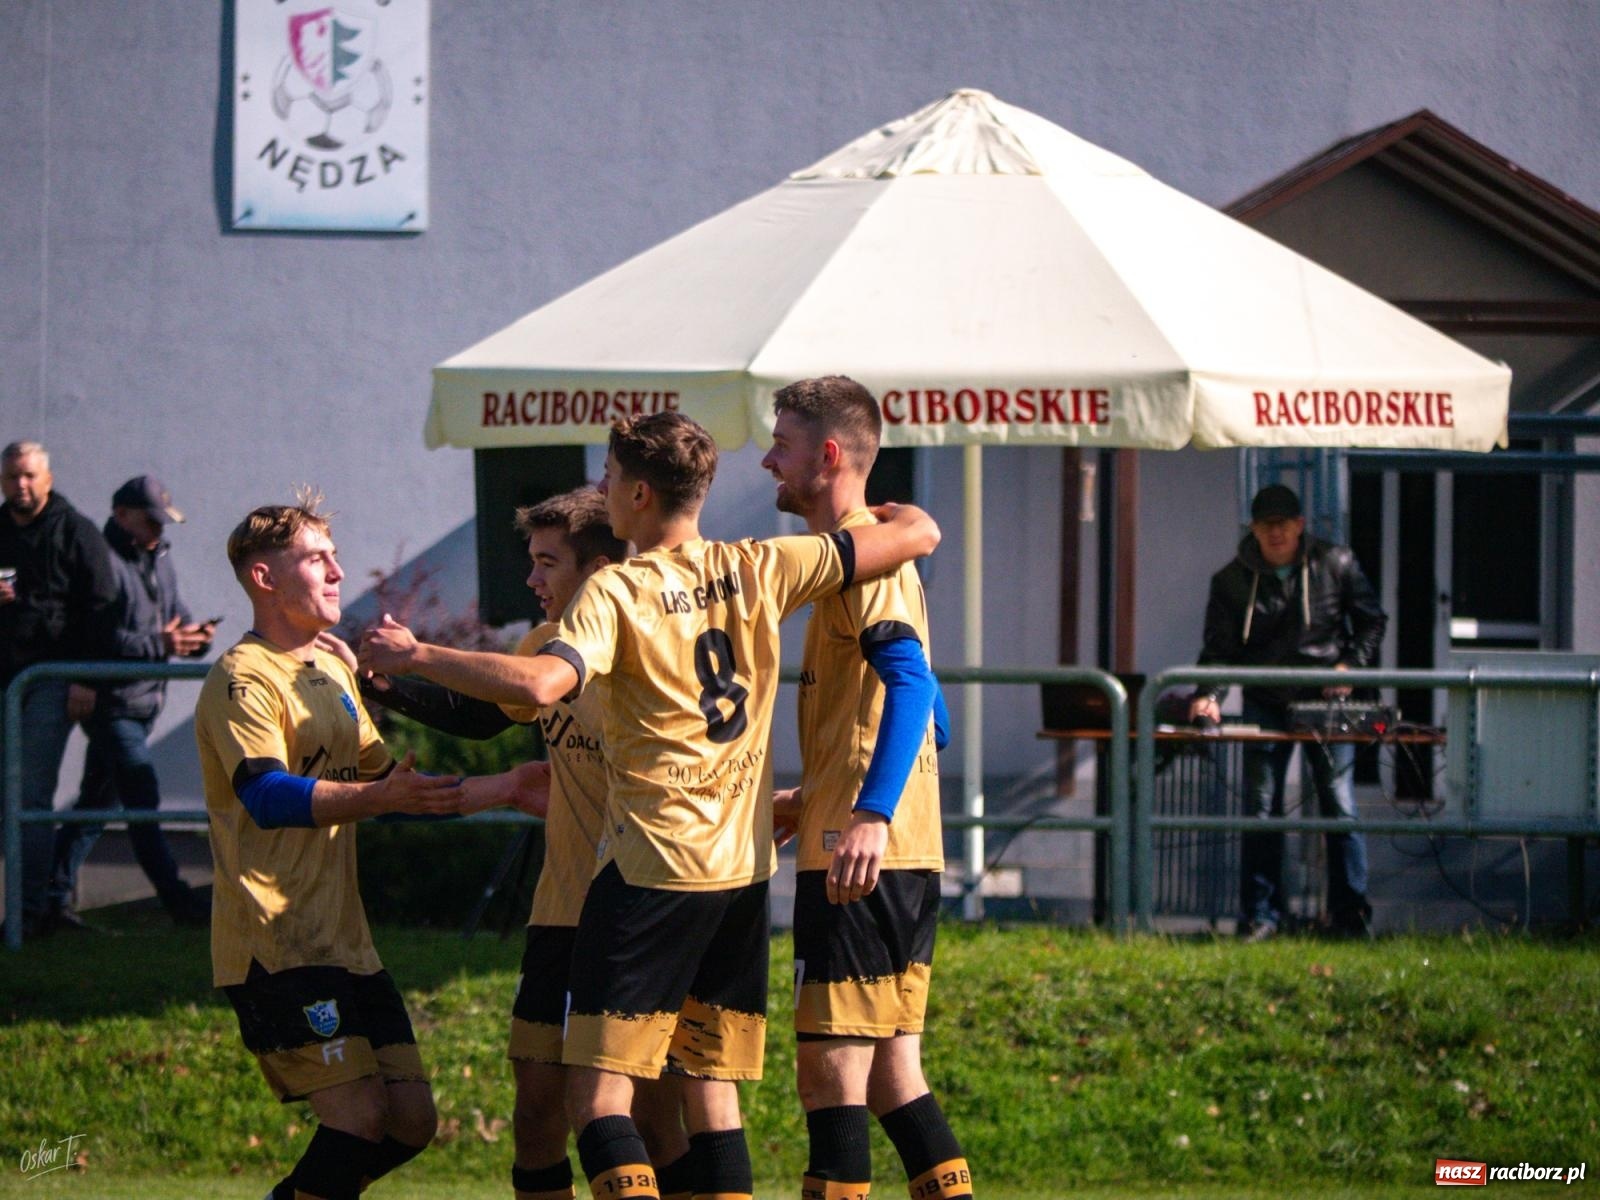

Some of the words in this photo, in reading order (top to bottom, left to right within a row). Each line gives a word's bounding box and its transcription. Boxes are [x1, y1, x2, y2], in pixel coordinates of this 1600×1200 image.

[257, 137, 406, 193] NĘDZA
[881, 388, 1110, 425] CIBORSKIE
[1253, 390, 1454, 428] RACIBORSKIE
[694, 628, 750, 744] 8
[916, 1169, 970, 1199] 1936
